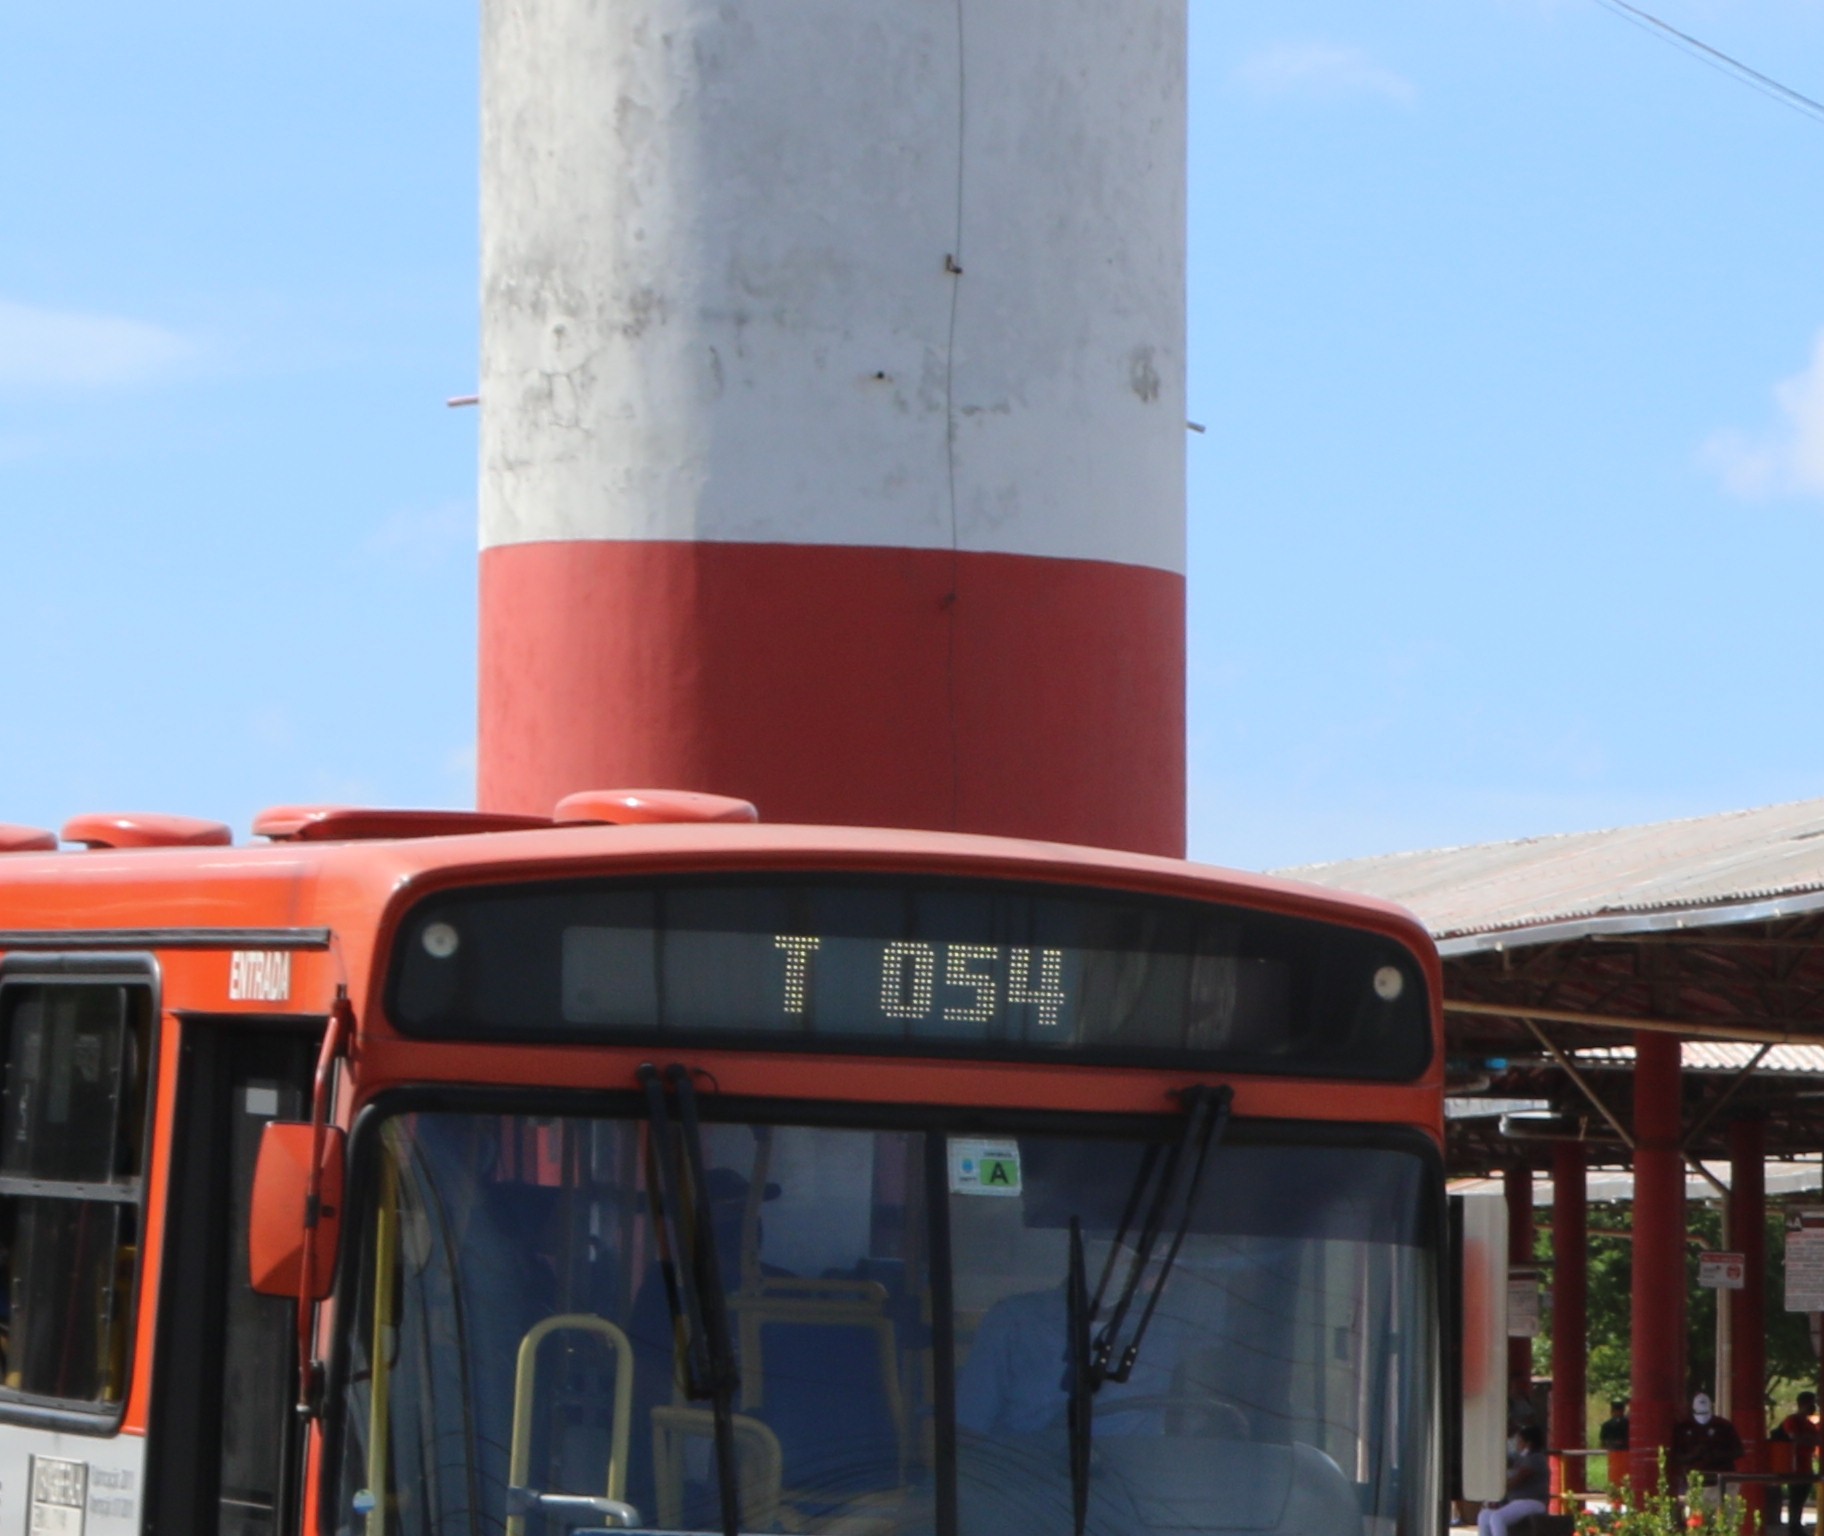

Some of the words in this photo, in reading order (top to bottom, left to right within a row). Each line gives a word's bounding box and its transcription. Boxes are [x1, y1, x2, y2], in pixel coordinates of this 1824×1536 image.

[229, 951, 291, 1001] ENTRADA
[774, 935, 820, 1013] T
[880, 941, 1065, 1026] 054
[990, 1161, 1009, 1184] A
